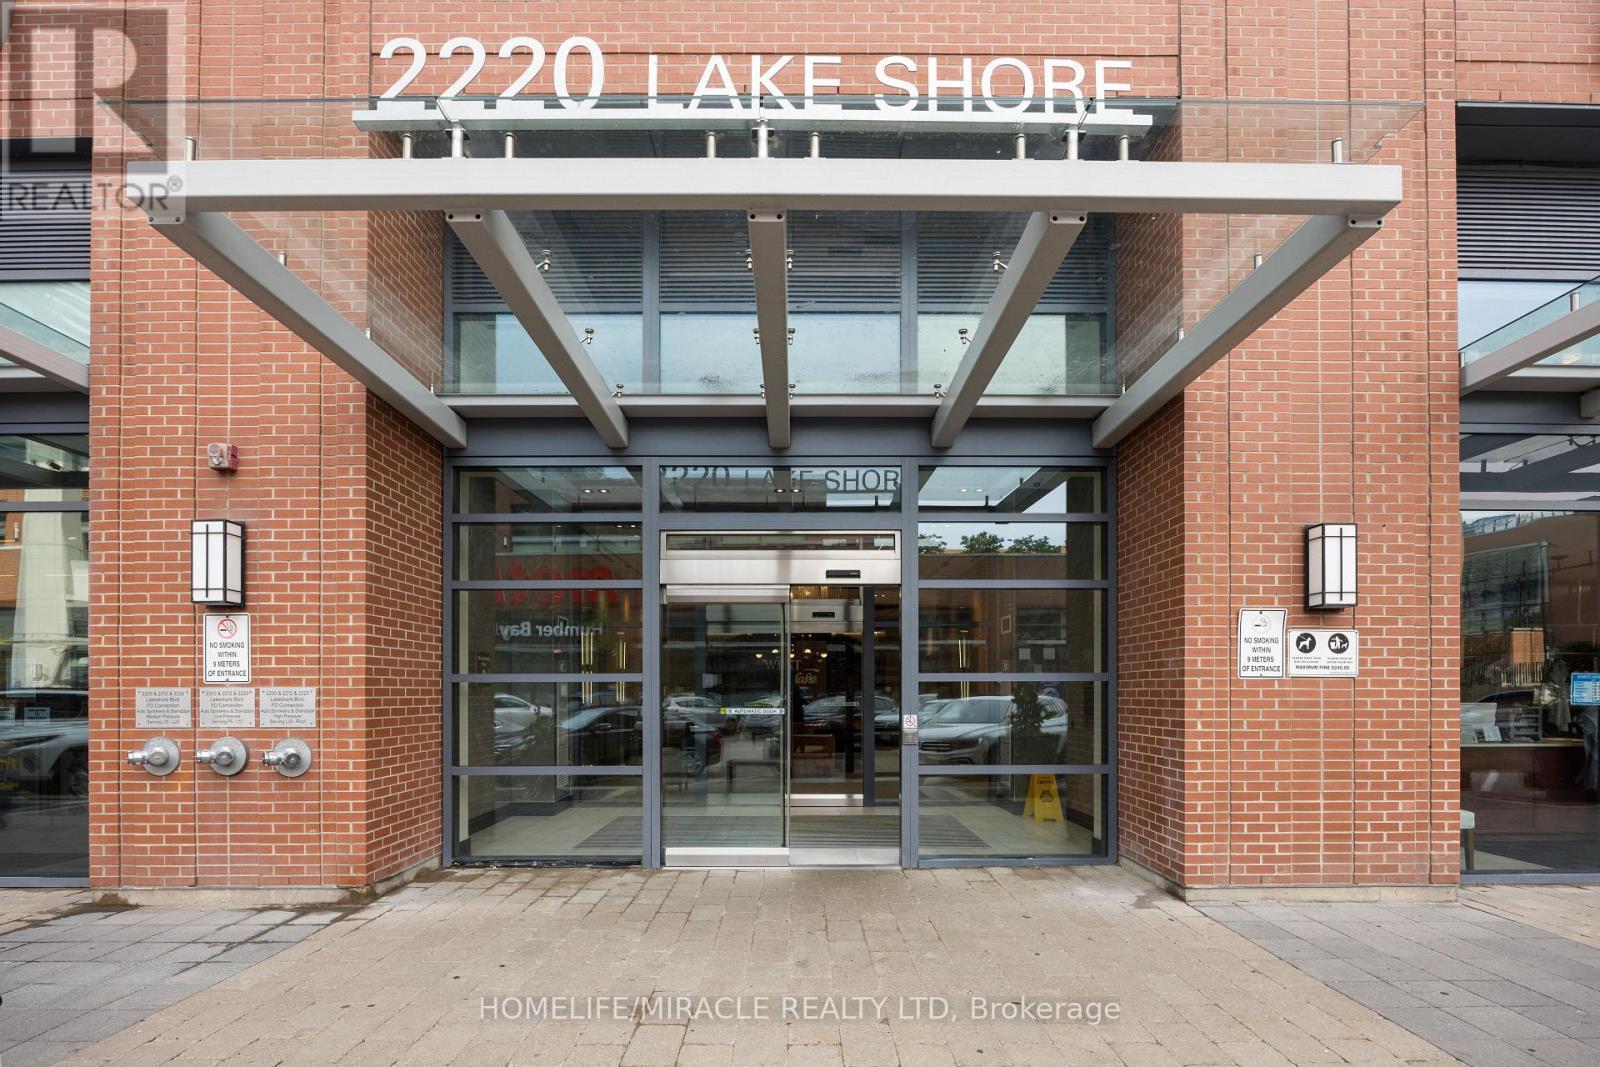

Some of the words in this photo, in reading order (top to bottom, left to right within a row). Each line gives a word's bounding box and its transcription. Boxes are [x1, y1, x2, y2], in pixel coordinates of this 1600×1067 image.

[376, 36, 605, 110] 2220
[647, 54, 843, 110] LAKE
[873, 54, 1135, 111] SHORE
[212, 660, 217, 668] 9
[218, 660, 240, 668] METERS
